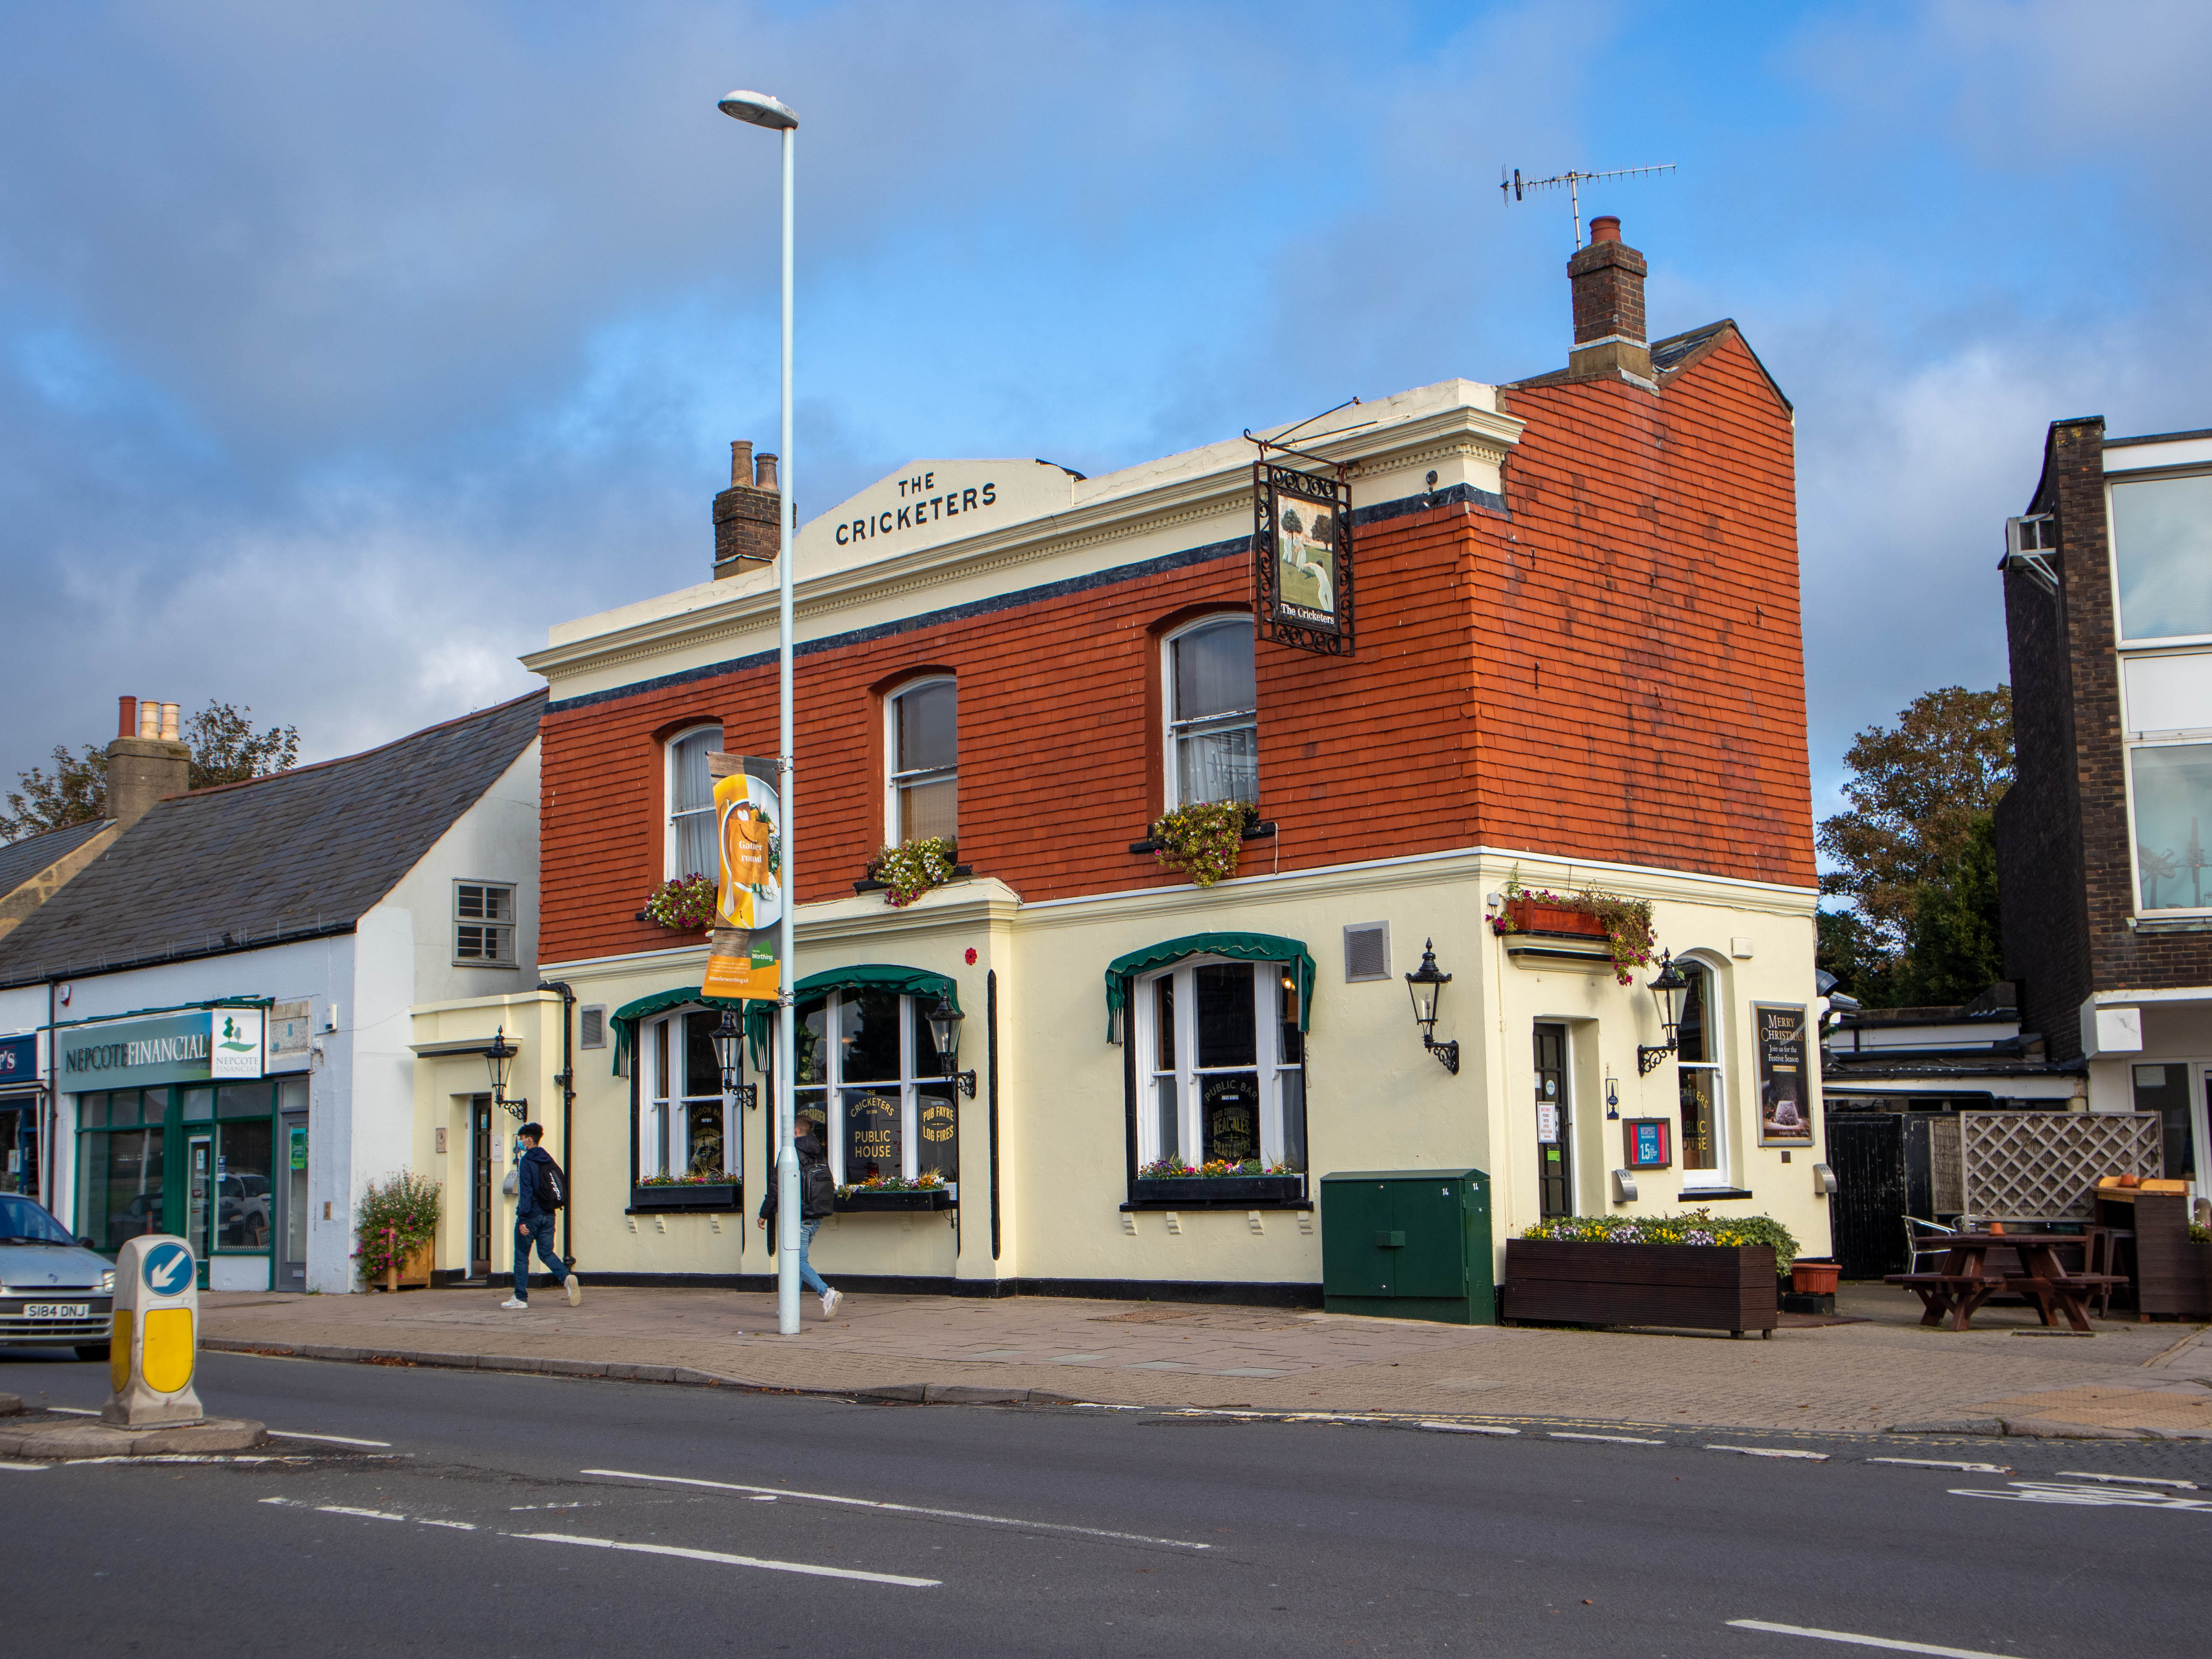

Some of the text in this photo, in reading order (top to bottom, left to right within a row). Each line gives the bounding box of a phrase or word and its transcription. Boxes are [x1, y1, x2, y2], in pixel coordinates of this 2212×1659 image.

[898, 472, 934, 497] THE
[836, 483, 996, 545] CRICKETERS
[1281, 603, 1334, 625] The Cricketers
[739, 840, 763, 851] Gather
[742, 853, 762, 864] round
[752, 953, 773, 961] Worthing
[709, 975, 749, 984] timeforworthing.uk
[1768, 1015, 1795, 1029] MERRY
[1761, 1027, 1803, 1042] CHRISTMAS
[1769, 1045, 1778, 1053] Join
[216, 1057, 259, 1065] NEPCOTE
[1768, 1054, 1799, 1063] Festive Season
[1205, 1080, 1257, 1102] PUBLIC BAR
[851, 1098, 894, 1117] CRICKETERS
[923, 1106, 954, 1123] PUB FAYRE
[1213, 1107, 1249, 1120] CASK CONDITIONED
[690, 1107, 711, 1123] SALOON
[809, 1108, 826, 1124] GARDEN
[1214, 1116, 1249, 1136] REAL ALES
[855, 1130, 891, 1143] PUBLIC
[923, 1125, 954, 1142] LOG FIRES
[855, 1145, 891, 1158] HOUSE
[1214, 1138, 1251, 1158] CRAFT BEERS
[1640, 1143, 1650, 1160] 1.5
[1473, 1182, 1479, 1190] 14
[29, 1305, 85, 1317] S184 DNJ
